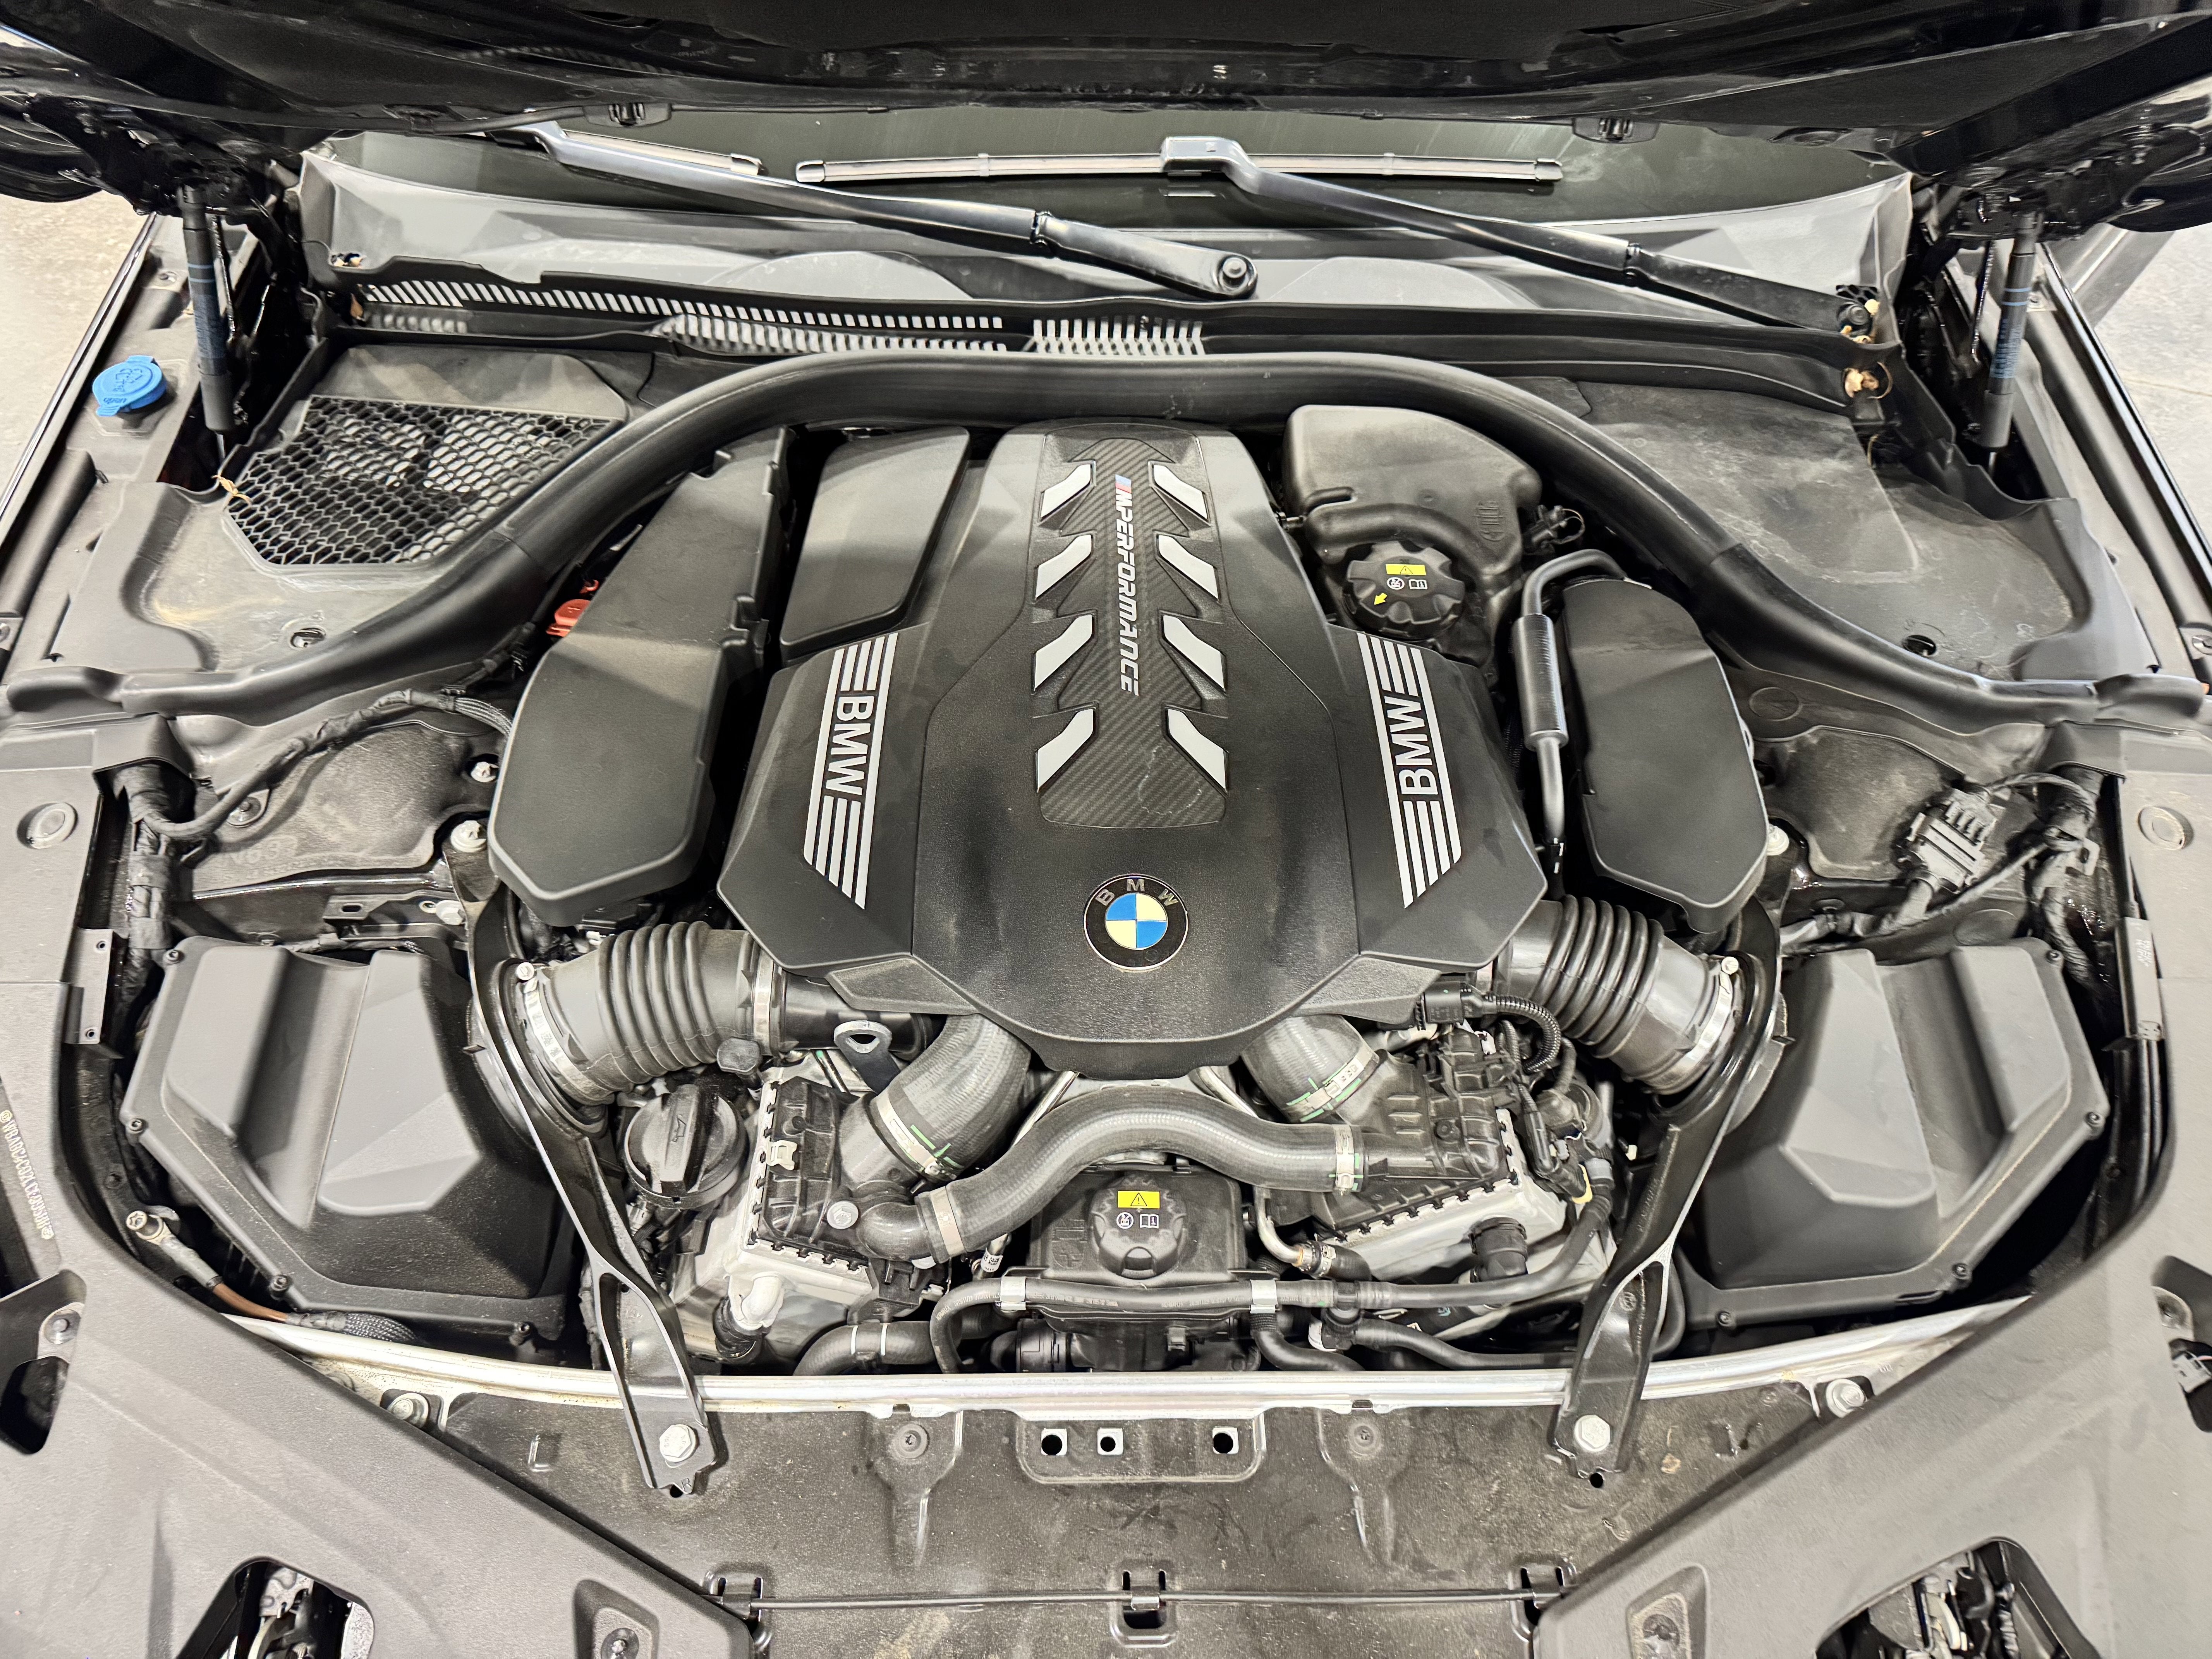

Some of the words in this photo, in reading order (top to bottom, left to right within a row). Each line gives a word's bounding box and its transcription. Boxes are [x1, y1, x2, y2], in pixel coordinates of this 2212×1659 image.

[1116, 506, 1139, 696] PERFORMANCE
[826, 696, 875, 796] BMW
[1384, 696, 1438, 795] BMW
[1095, 878, 1178, 906] BMW
